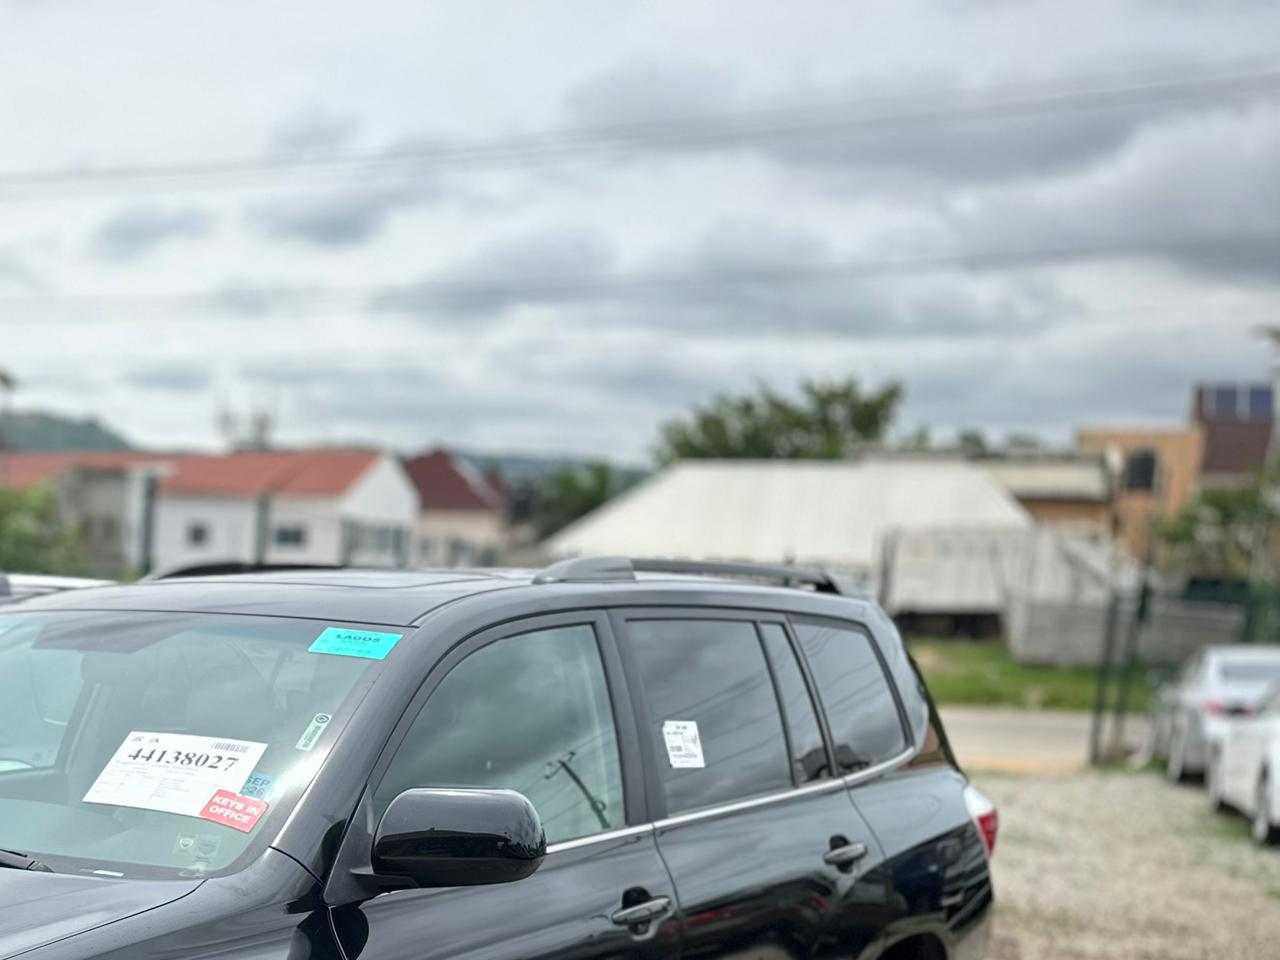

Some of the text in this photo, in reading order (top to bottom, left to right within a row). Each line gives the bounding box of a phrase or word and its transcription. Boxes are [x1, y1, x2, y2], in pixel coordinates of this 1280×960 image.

[128, 748, 240, 771] 44138027
[209, 805, 251, 823] OFFICE
[213, 796, 261, 816] KEYS IN
